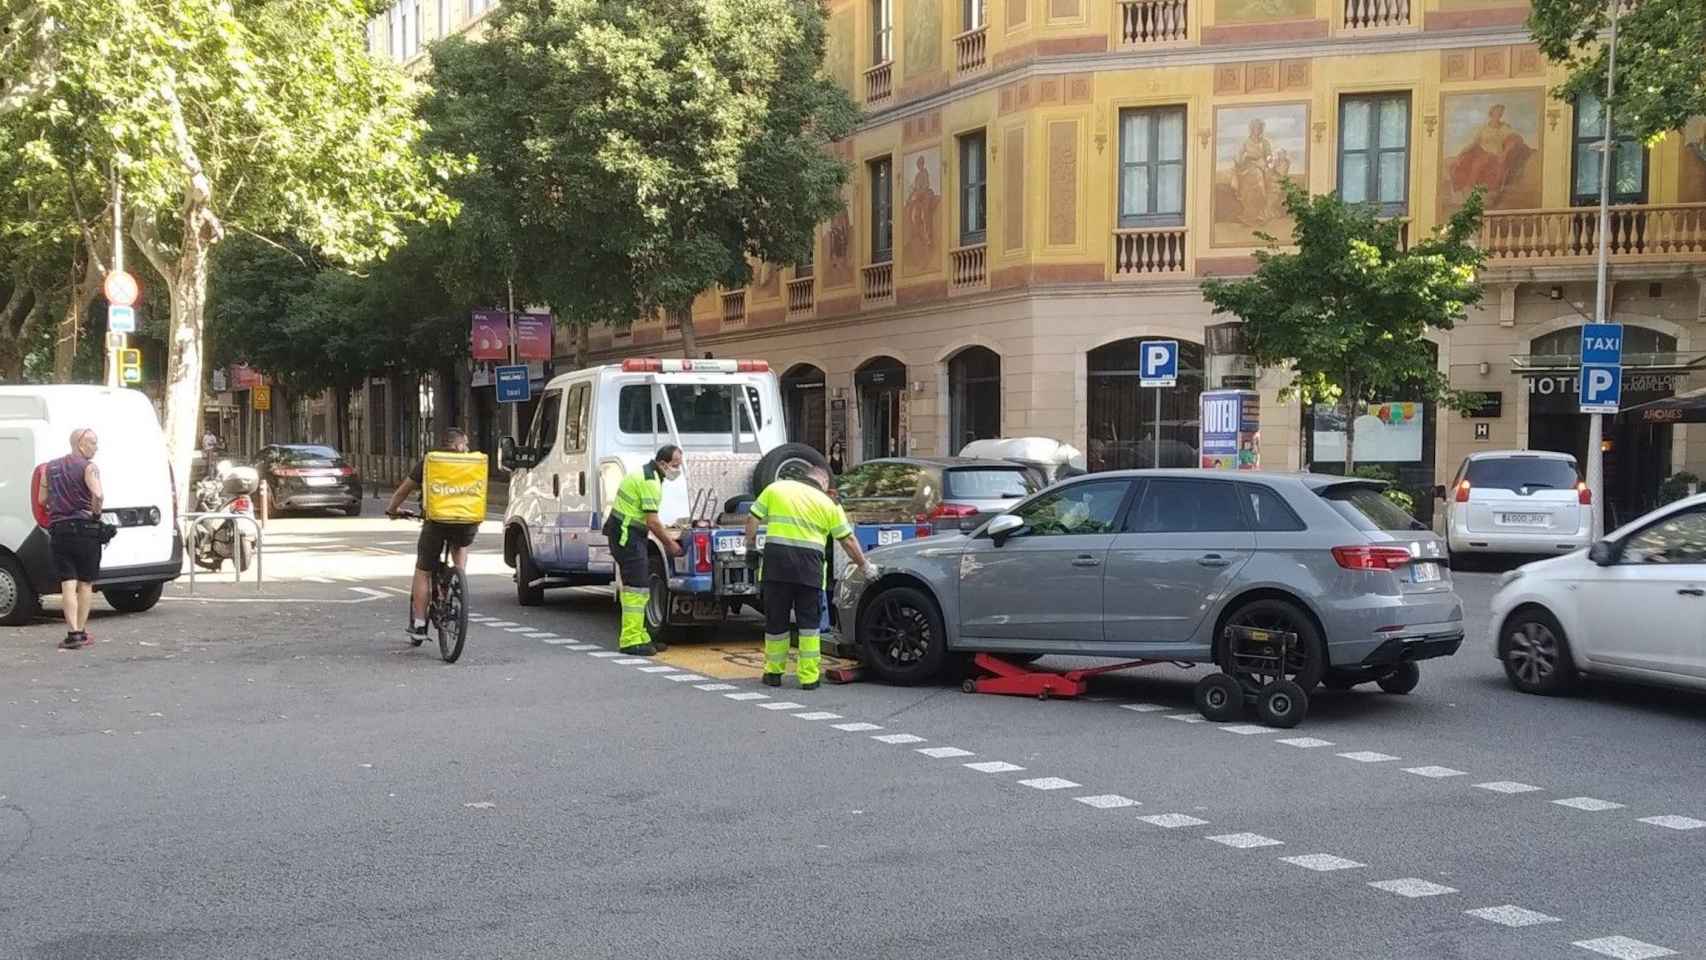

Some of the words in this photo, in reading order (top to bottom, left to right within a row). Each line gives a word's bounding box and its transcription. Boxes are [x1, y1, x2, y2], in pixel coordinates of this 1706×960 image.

[1584, 337, 1619, 351] TAXI
[1147, 346, 1170, 375] P
[1587, 369, 1613, 401] P
[1203, 399, 1238, 433] VOTEU
[880, 531, 900, 545] SP
